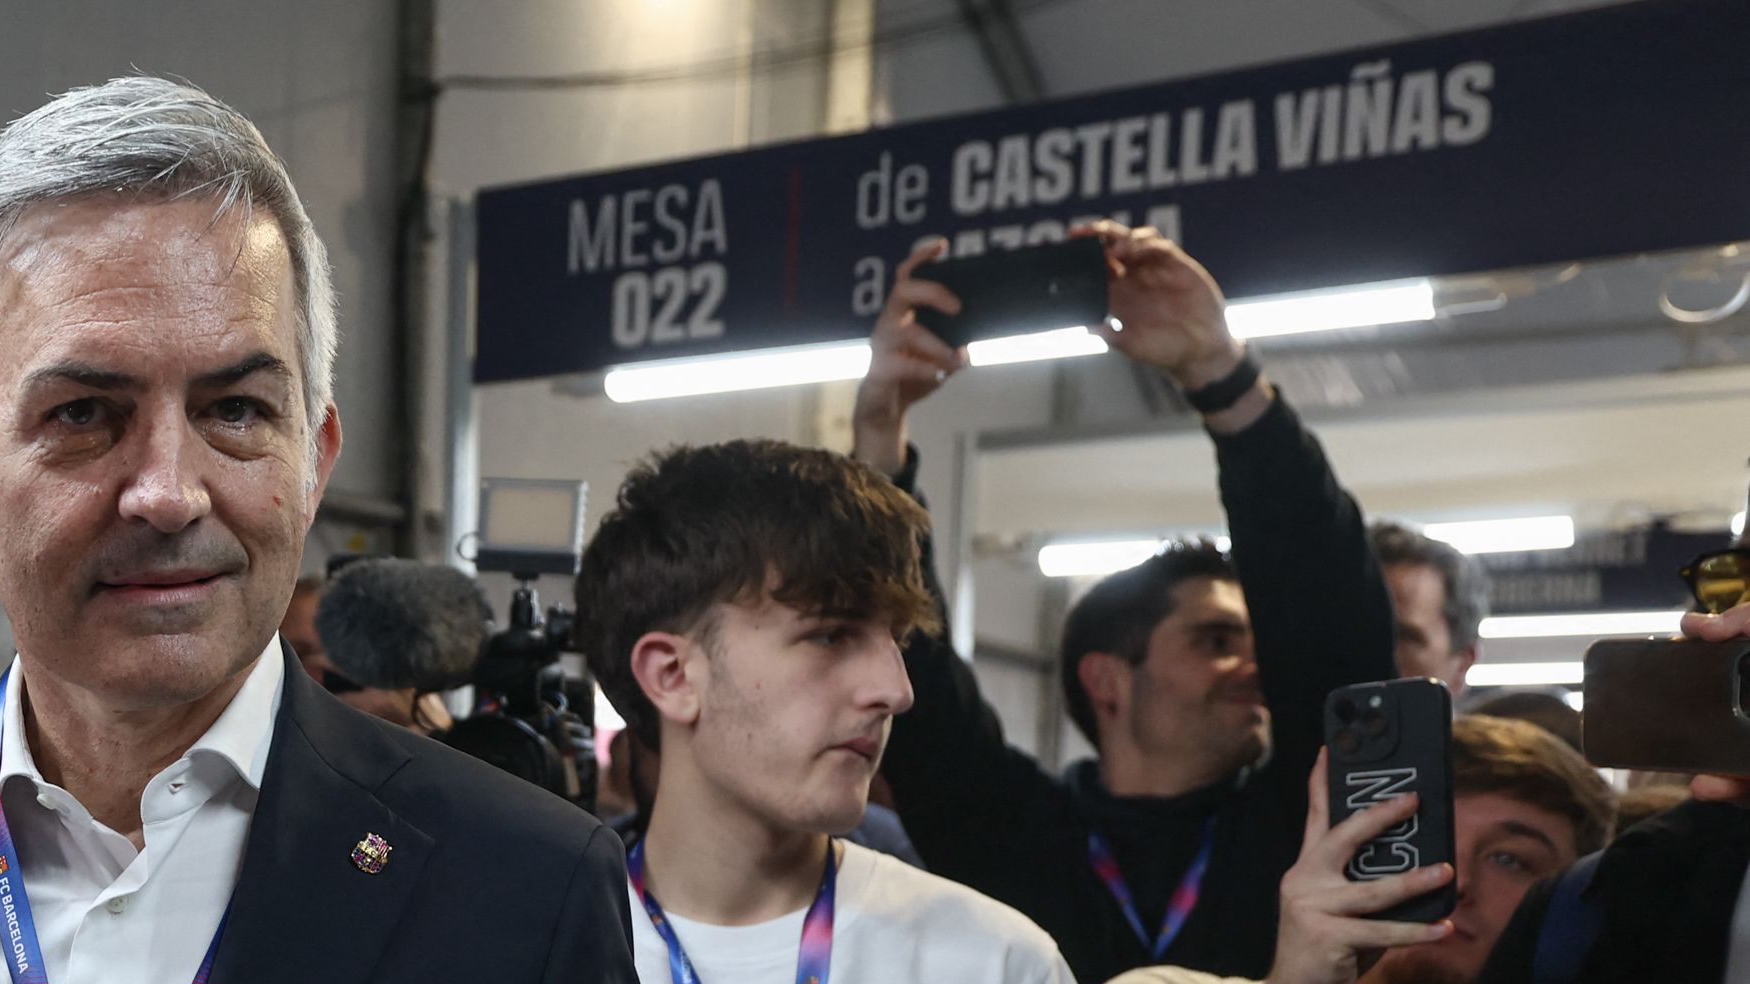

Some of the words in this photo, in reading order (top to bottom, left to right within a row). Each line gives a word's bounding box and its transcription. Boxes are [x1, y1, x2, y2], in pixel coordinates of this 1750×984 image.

[855, 150, 929, 229] de
[952, 97, 1257, 215] CASTELLA
[1274, 60, 1495, 171] VIÑAS
[567, 178, 728, 274] MESA
[611, 261, 727, 347] 022
[852, 255, 886, 317] a
[2, 894, 29, 975] BARCELONA
